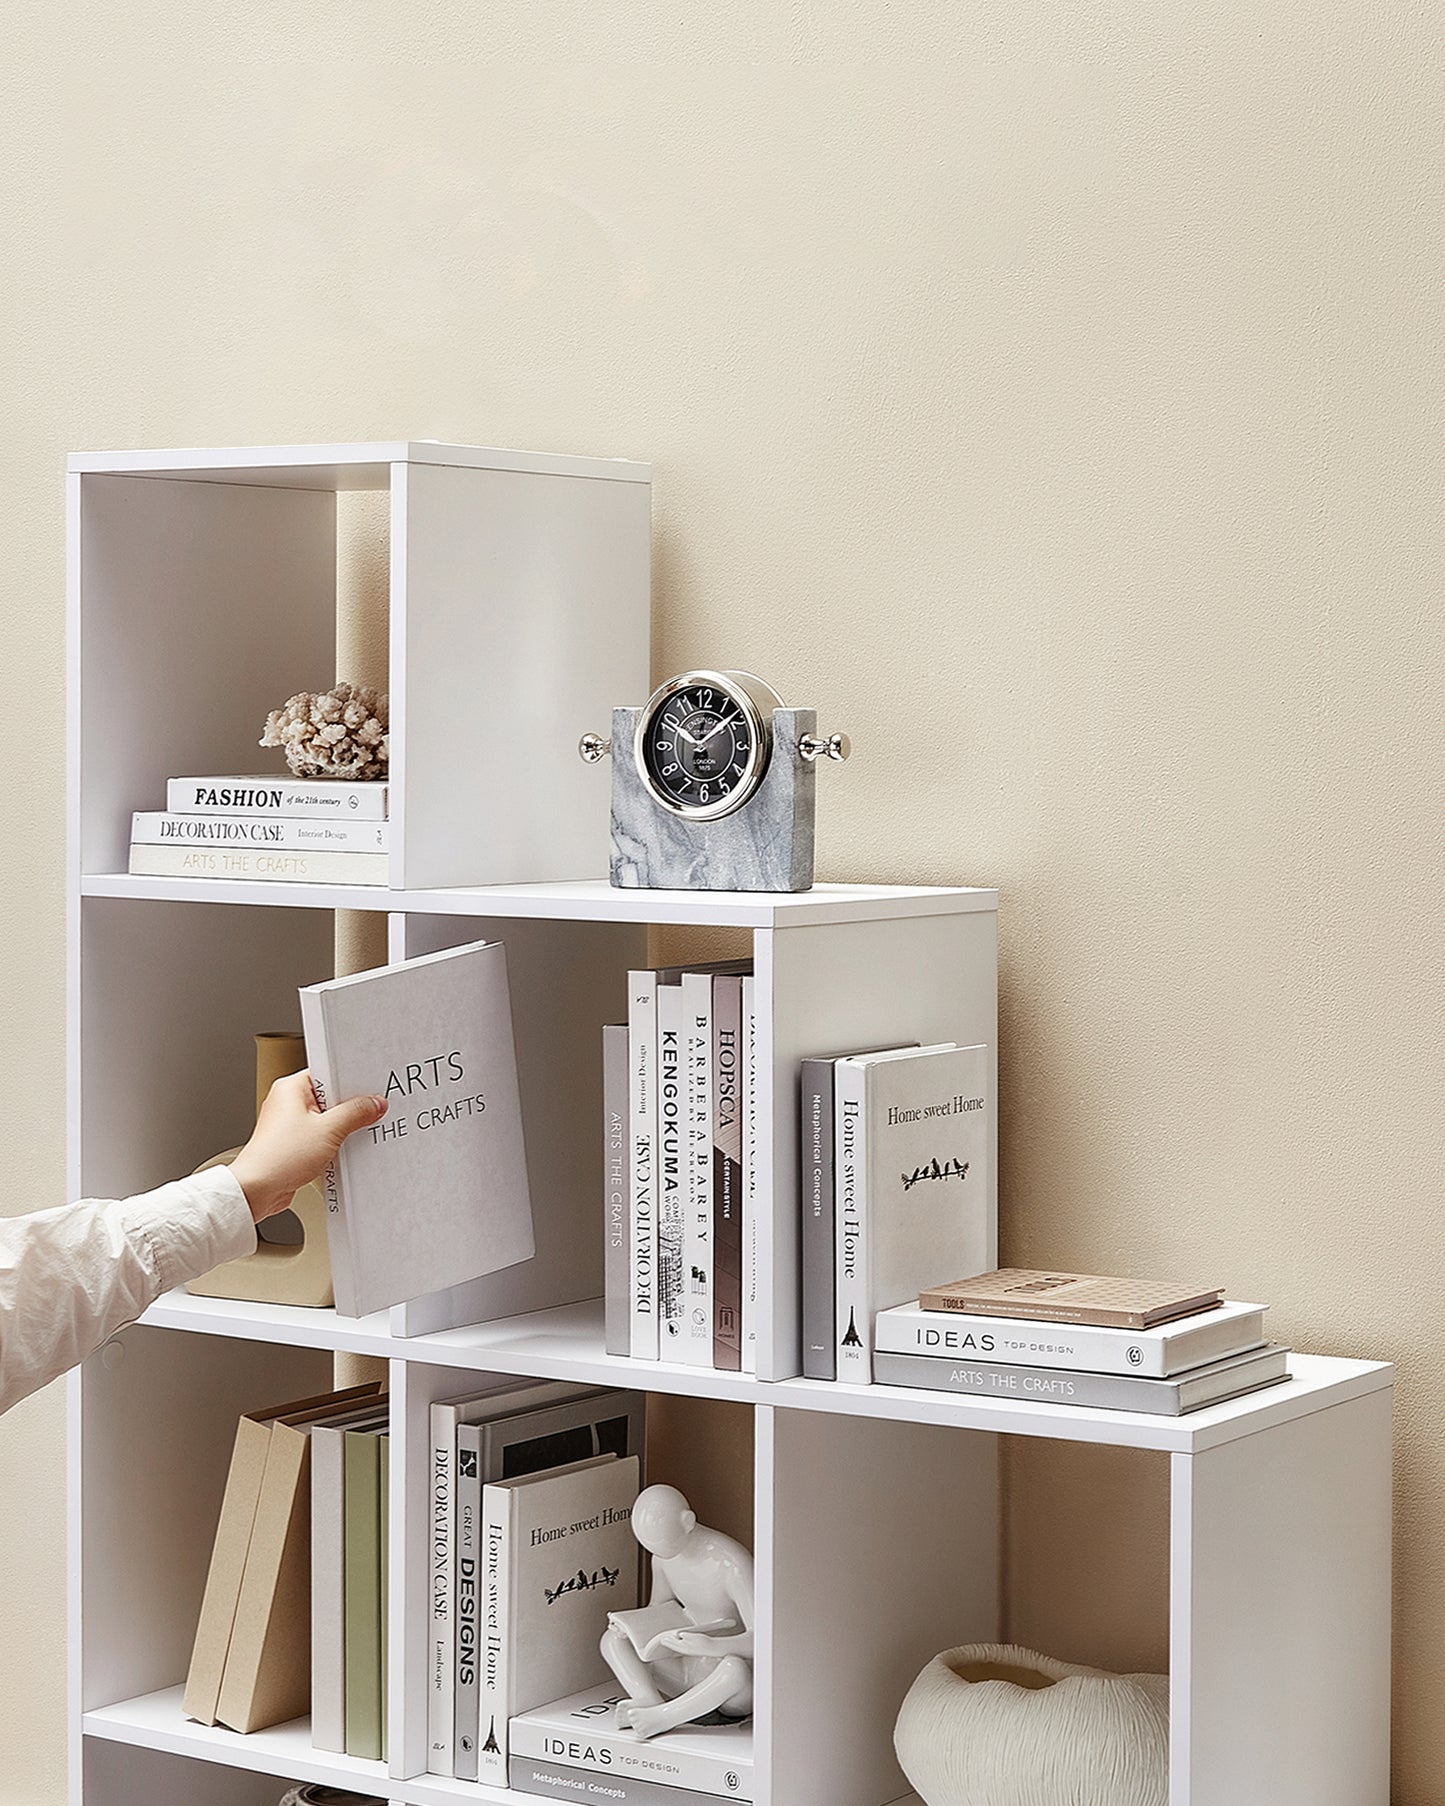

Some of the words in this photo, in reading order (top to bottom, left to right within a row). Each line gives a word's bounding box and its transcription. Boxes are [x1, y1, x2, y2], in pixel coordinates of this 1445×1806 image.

[676, 695, 694, 716] 11
[696, 689, 713, 708] 12
[720, 696, 731, 713] 1
[661, 713, 680, 733] 10
[730, 714, 746, 730] 2
[656, 741, 674, 752] 9
[736, 741, 750, 751] 3
[661, 762, 679, 777] 8
[677, 777, 692, 794] 7
[718, 776, 731, 796] 5
[732, 762, 745, 777] 4
[194, 788, 284, 808] FASHION
[286, 795, 295, 805] of
[294, 795, 304, 804] the
[318, 798, 341, 807] century
[700, 783, 709, 803] 6
[160, 821, 249, 840] DECORATION
[250, 825, 285, 842] CASE
[297, 828, 323, 838] Interior
[324, 830, 348, 840] Design
[182, 854, 217, 870] ARTS
[222, 855, 249, 872] THE
[255, 857, 308, 874] CRAFTS
[385, 1051, 464, 1099] ARTS
[638, 1044, 647, 1077] Design
[315, 1079, 328, 1112] ART
[695, 1015, 708, 1142] BARBERA
[719, 1029, 736, 1129] HOPSCA
[638, 1079, 647, 1115] Interior
[888, 1106, 922, 1126] Home
[923, 1103, 952, 1119] sweet
[953, 1095, 986, 1114] Home
[368, 1117, 409, 1145] THE
[416, 1094, 487, 1131] CRAFTS
[611, 1112, 622, 1150] ARTS
[812, 1094, 822, 1164] Metaphorical
[843, 1100, 859, 1160] Home
[611, 1156, 623, 1186] THE
[636, 1134, 651, 1183] CASE
[723, 1161, 732, 1193] CERTAIN
[812, 1168, 822, 1218] Concepts
[844, 1164, 857, 1214] sweet
[697, 1154, 709, 1242] BAREY
[723, 1194, 731, 1220] STYLE
[611, 1192, 623, 1248] CRAFTS
[636, 1186, 652, 1315] DECORATION
[844, 1220, 860, 1280] Home
[942, 1297, 965, 1310] TOOLS
[916, 1328, 996, 1351] IDEAS
[1003, 1340, 1028, 1349] TOP
[1029, 1343, 1074, 1355] DESIGN
[950, 1368, 985, 1386] ARTS
[988, 1373, 1018, 1389] THE
[1022, 1376, 1075, 1396] CRAFTS
[433, 1447, 449, 1571] DECORATION
[463, 1505, 473, 1549] GREAT
[530, 1526, 568, 1547] Home
[569, 1516, 601, 1536] sweet
[602, 1507, 632, 1527] Hom
[489, 1523, 503, 1578] Home
[434, 1574, 448, 1621] CASE
[488, 1583, 499, 1629] sweet
[460, 1558, 475, 1686] DESIGNS
[435, 1640, 444, 1691] Landscape
[486, 1635, 502, 1690] Home
[543, 1737, 613, 1765] IDEAS
[619, 1756, 640, 1766] TOP
[641, 1761, 681, 1774] DESIGN
[532, 1771, 586, 1791] Metaphorical
[587, 1783, 627, 1799] Concepts
